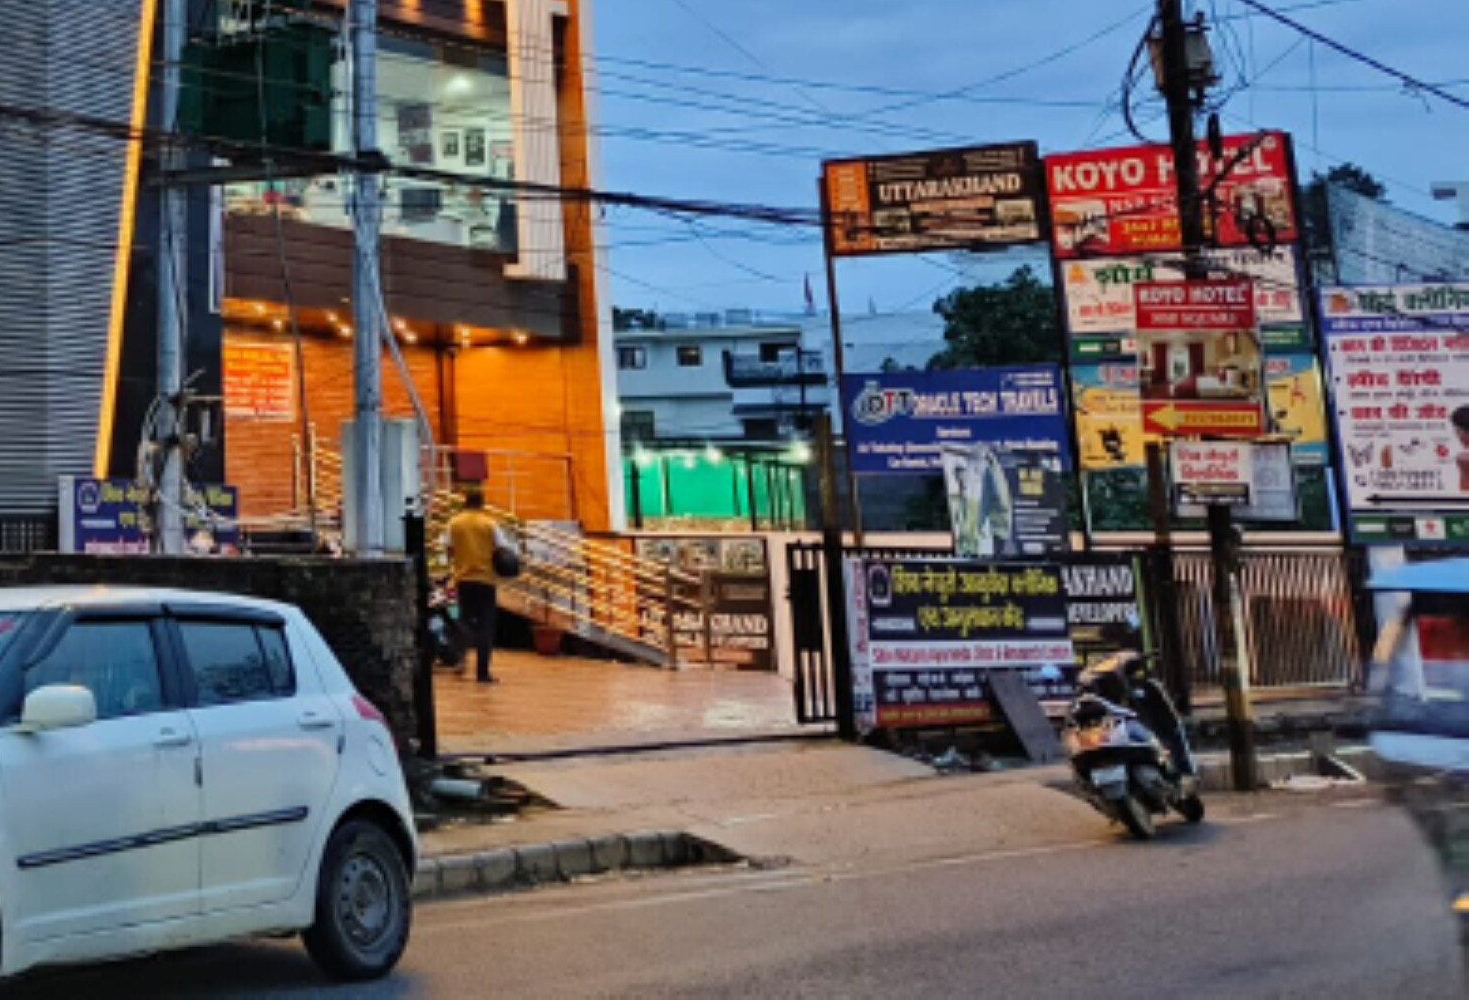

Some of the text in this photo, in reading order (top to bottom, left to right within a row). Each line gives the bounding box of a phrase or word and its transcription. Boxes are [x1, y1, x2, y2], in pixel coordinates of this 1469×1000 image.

[1051, 157, 1145, 192] KOYO
[1157, 145, 1274, 184] HTEL
[879, 173, 1021, 202] UTTARAKHAND
[1138, 286, 1185, 304] KOYO
[1188, 285, 1244, 304] HOTEL
